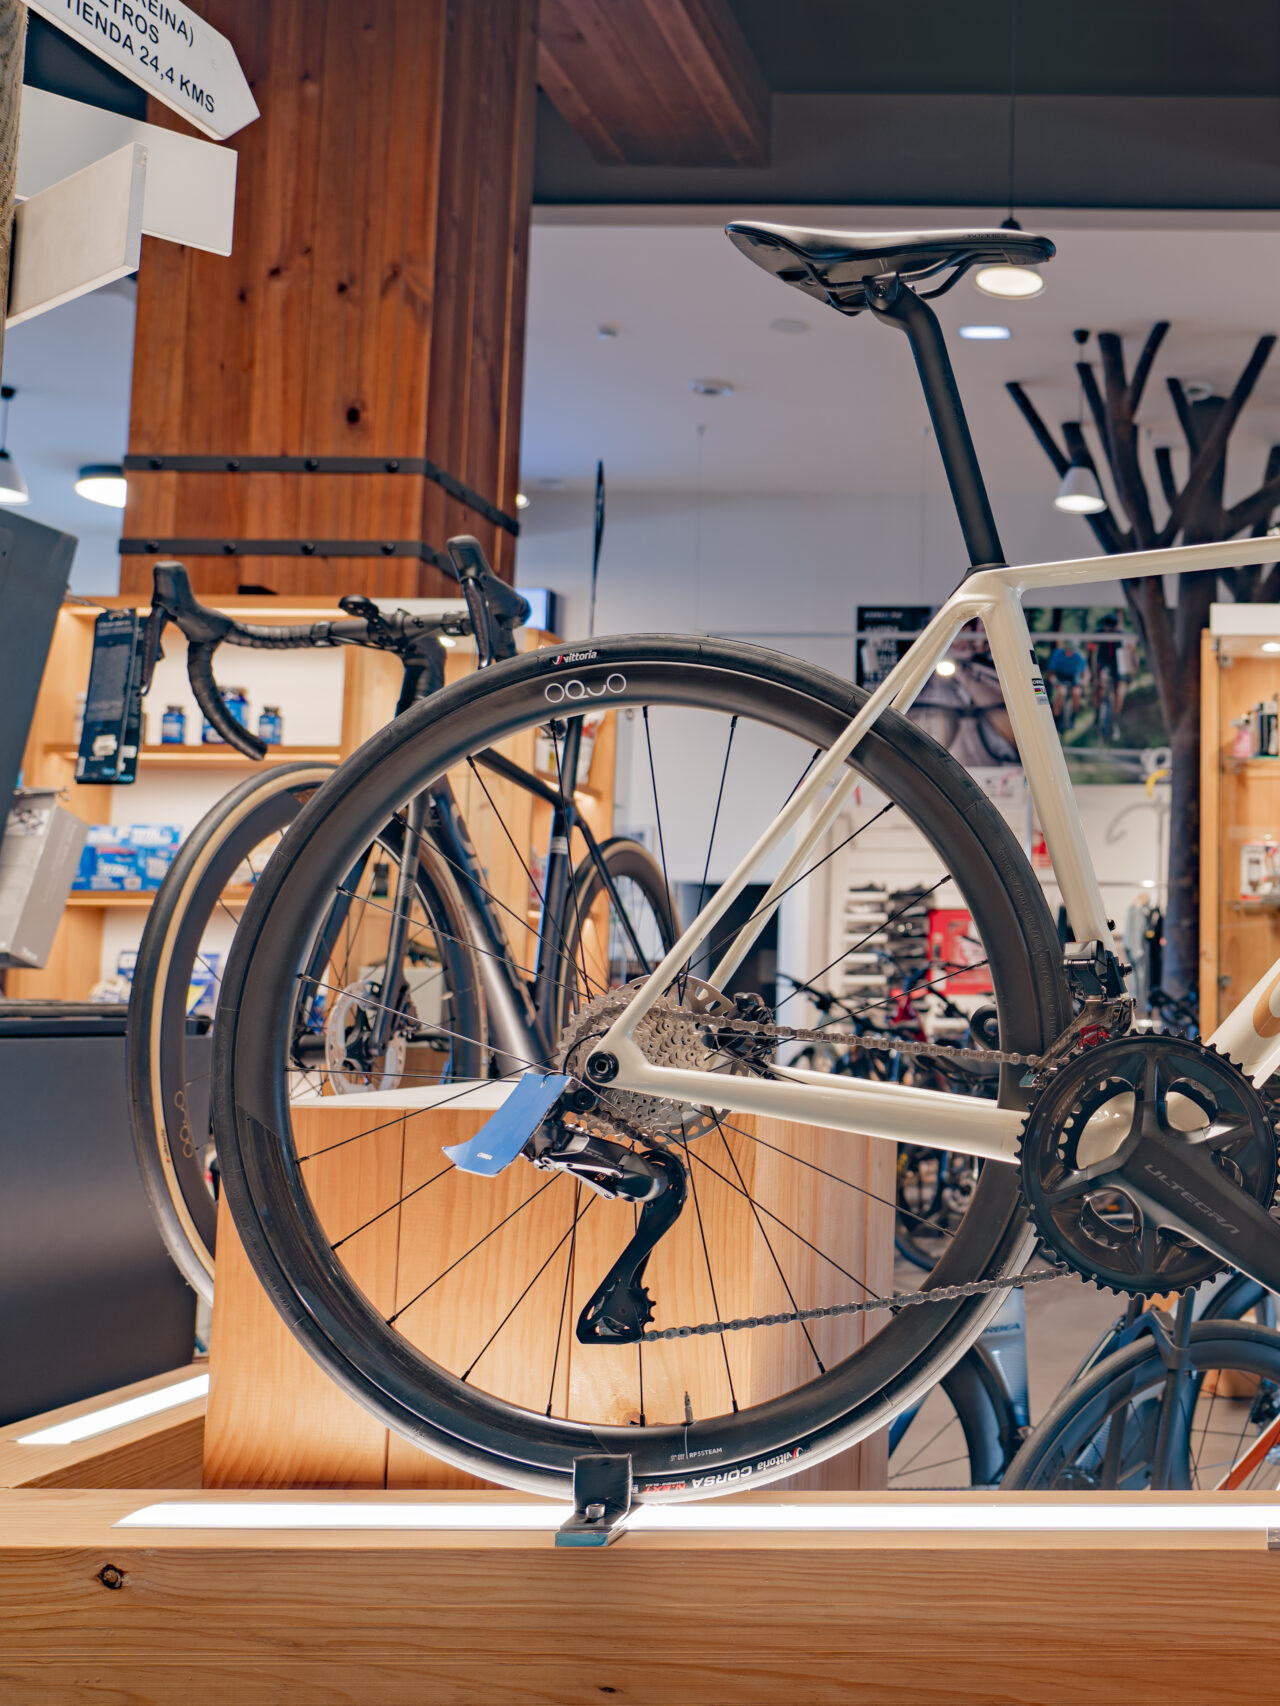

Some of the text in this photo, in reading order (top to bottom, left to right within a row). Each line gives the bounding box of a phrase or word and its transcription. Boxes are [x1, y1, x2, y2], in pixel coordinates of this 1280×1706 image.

[99, 0, 159, 44] TROS
[139, 46, 175, 84] 24,4
[180, 74, 215, 113] KMS
[562, 650, 598, 664] vittoria
[544, 673, 627, 703] OQUO
[1144, 1164, 1240, 1235] ULTEGRA
[757, 1451, 793, 1472] vittoria
[692, 1465, 753, 1489] CORSA
